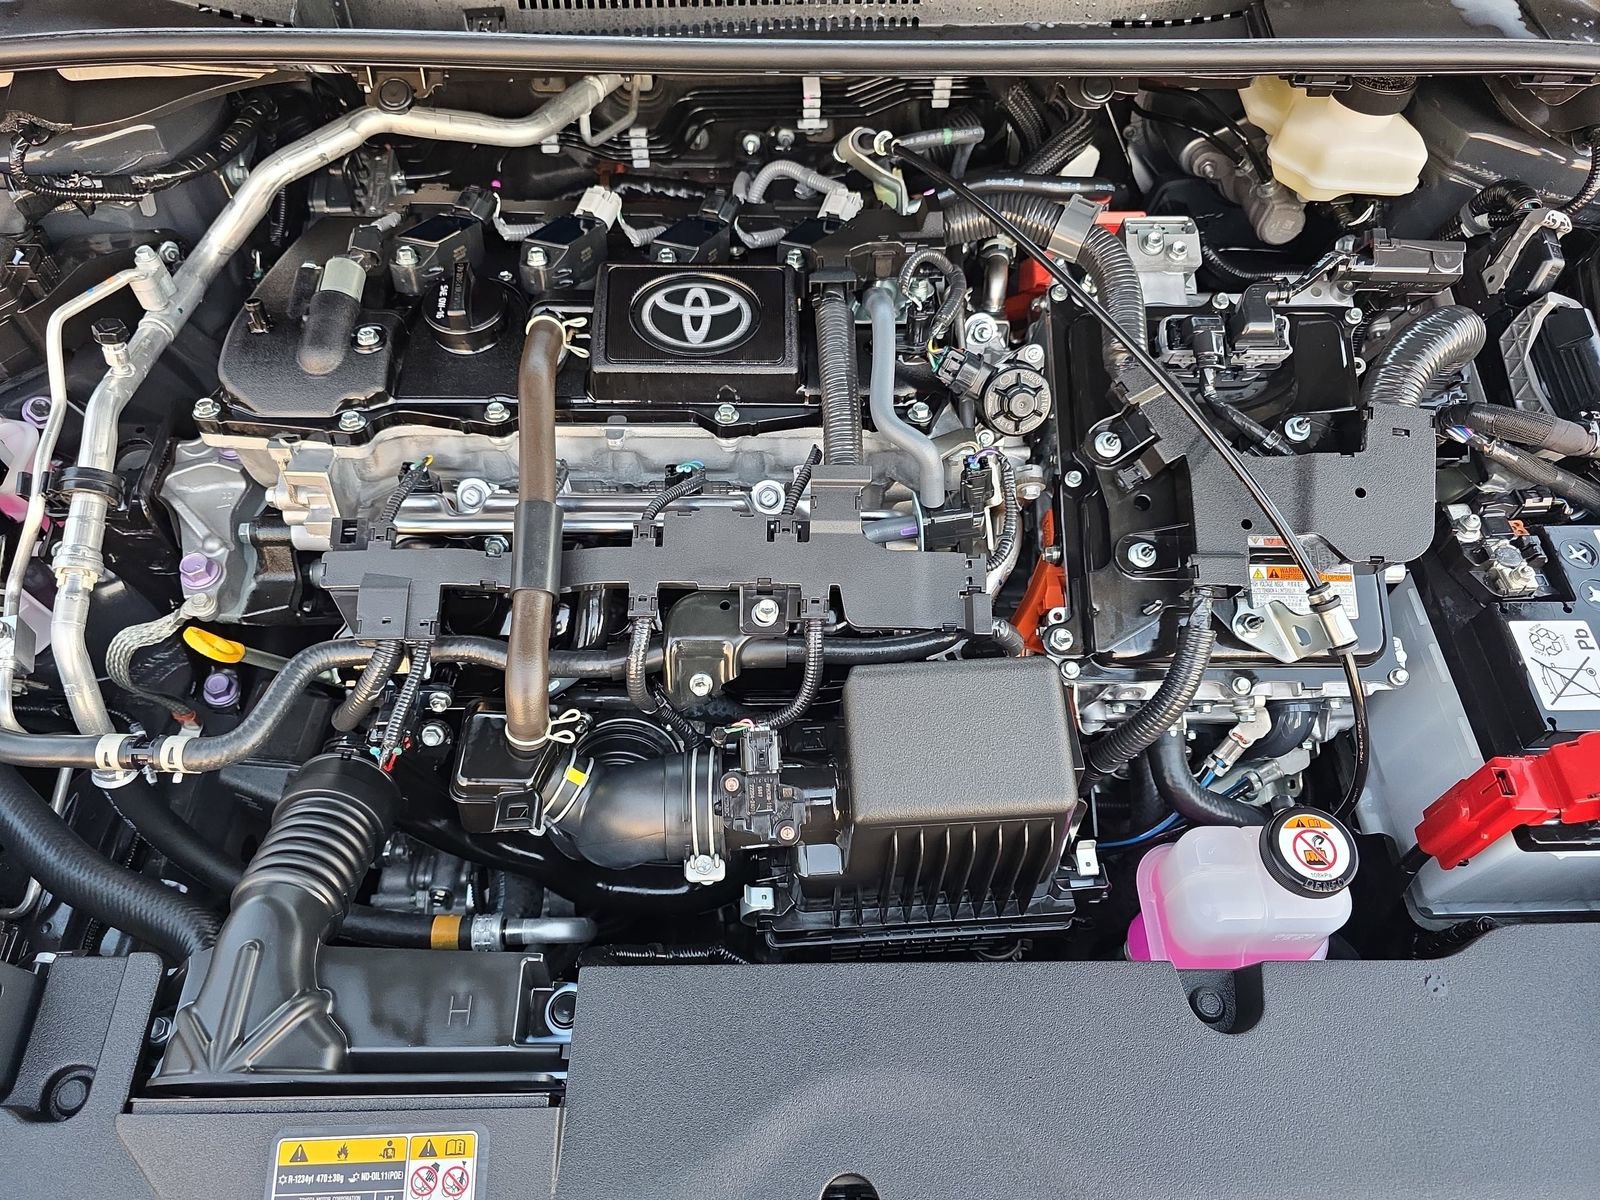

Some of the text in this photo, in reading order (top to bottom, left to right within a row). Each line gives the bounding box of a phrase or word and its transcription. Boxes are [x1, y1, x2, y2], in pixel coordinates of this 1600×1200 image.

[435, 284, 449, 319] SAE 0W-16
[1574, 628, 1596, 650] Pb
[1303, 877, 1346, 892] DENSO
[287, 1174, 314, 1185] R-1234yf
